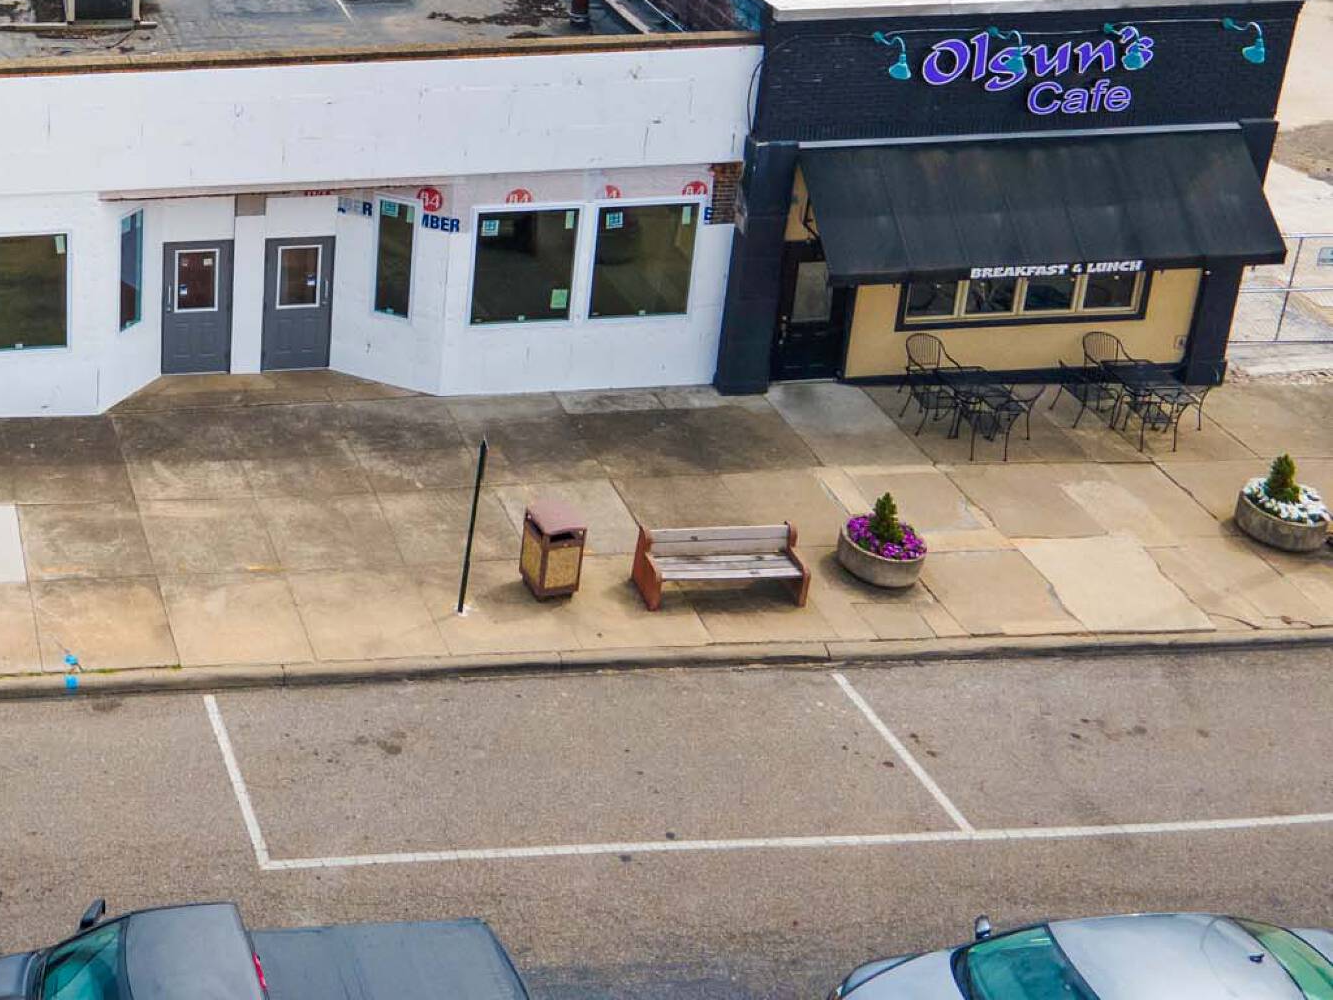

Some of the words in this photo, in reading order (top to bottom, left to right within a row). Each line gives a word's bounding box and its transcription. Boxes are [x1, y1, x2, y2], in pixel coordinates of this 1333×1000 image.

[922, 25, 1155, 92] Olgun's
[1027, 79, 1133, 116] Cafe
[970, 264, 1068, 279] BREAKFAST
[1086, 260, 1143, 273] LUNCH
